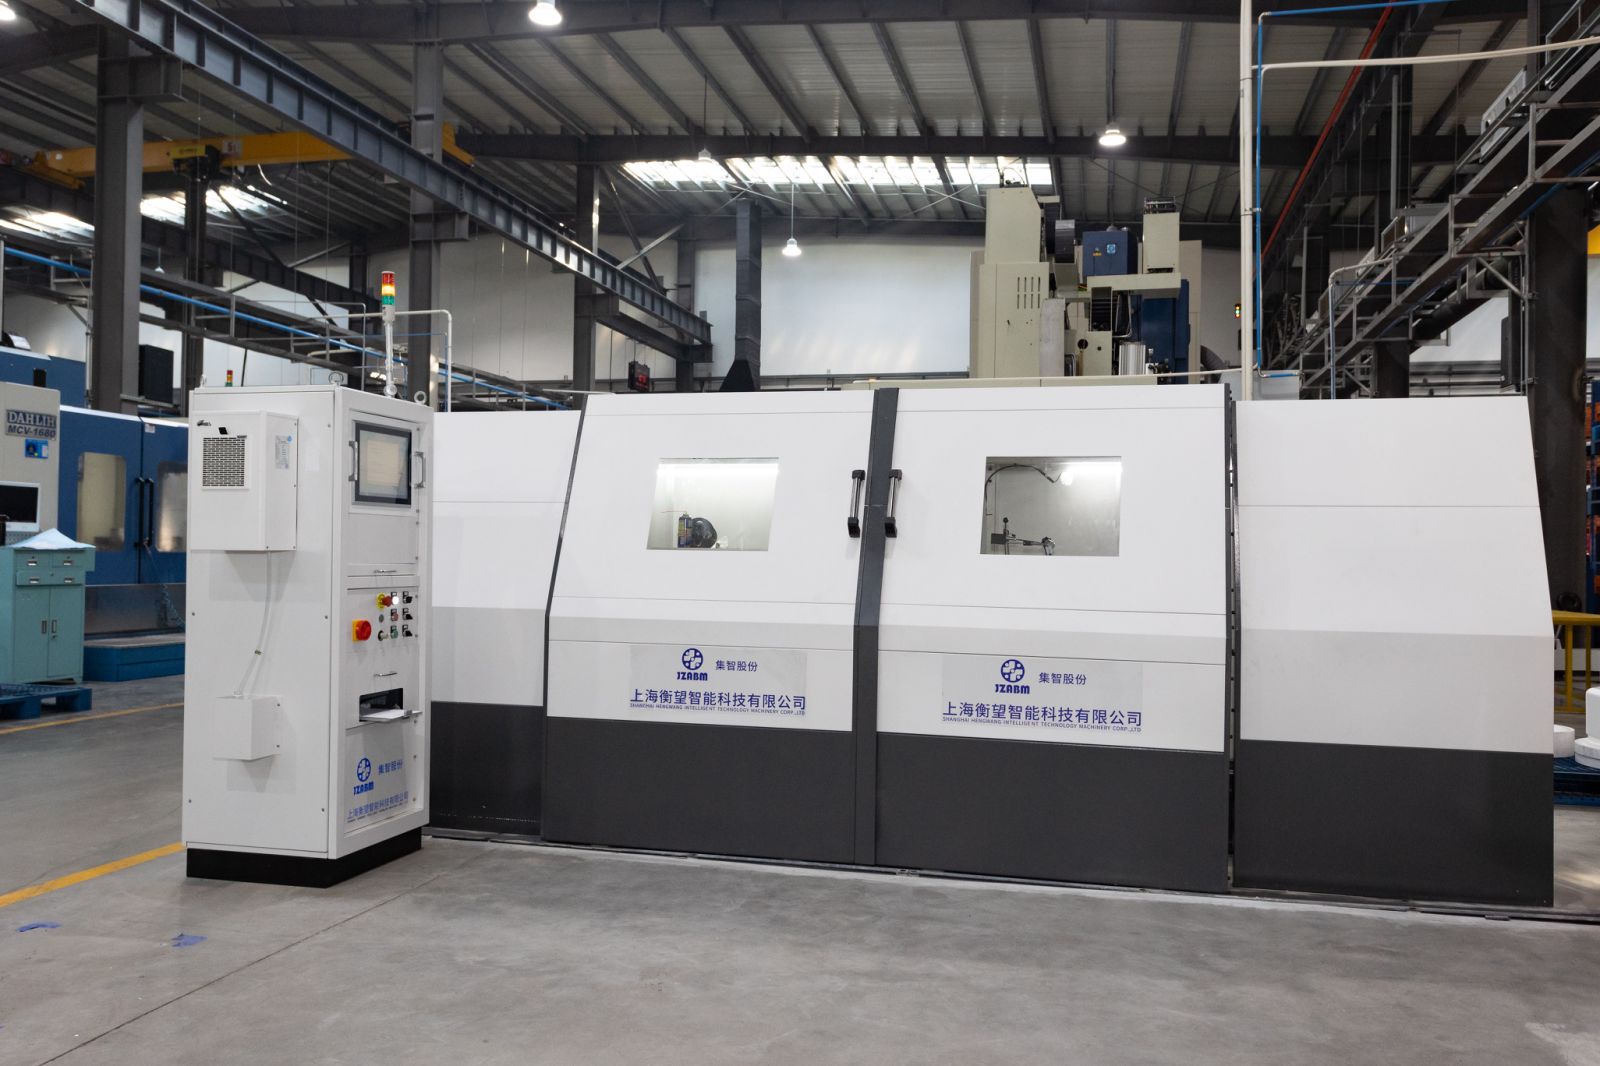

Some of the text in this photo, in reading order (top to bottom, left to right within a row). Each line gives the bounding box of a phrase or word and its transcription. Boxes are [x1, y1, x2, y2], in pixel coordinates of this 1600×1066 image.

[8, 411, 55, 427] DAHLIH
[8, 425, 56, 438] MCV-1680
[715, 660, 758, 672] 集智股份
[677, 672, 708, 681] JZABM
[1039, 672, 1087, 685] 集智股份
[995, 684, 1030, 694] JZABM
[630, 688, 806, 710] 上海衡望智能科技有限公司
[943, 701, 1142, 726] 上海衡望智能科技有限公司
[1003, 719, 1039, 727] INTELLIGENT
[1041, 721, 1077, 729] TECHNOLOGY
